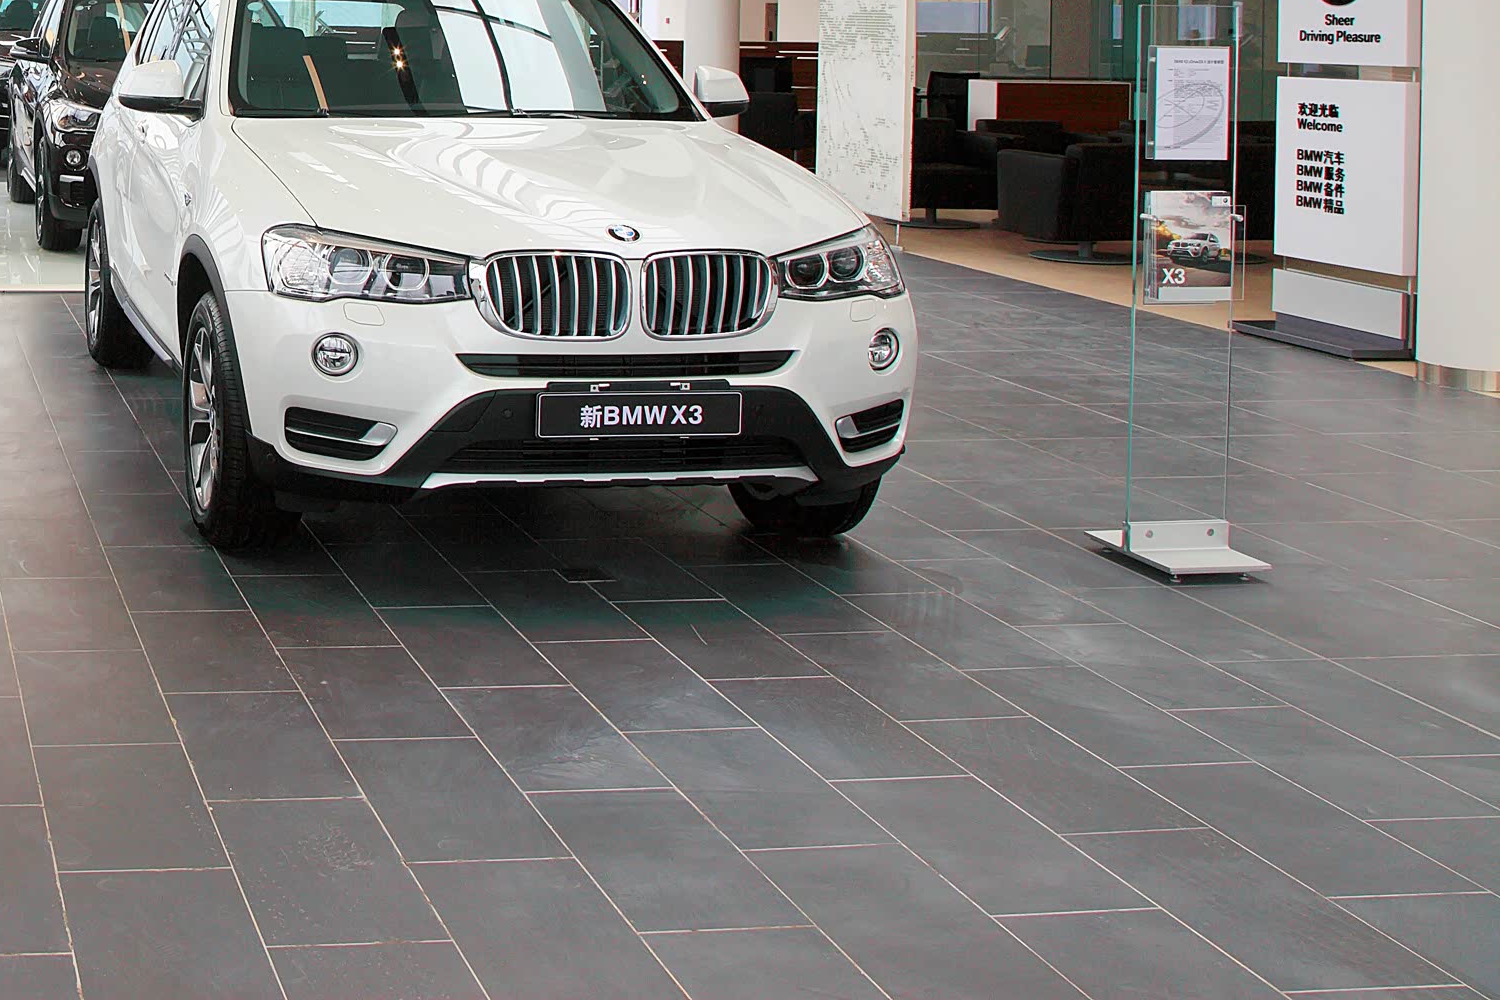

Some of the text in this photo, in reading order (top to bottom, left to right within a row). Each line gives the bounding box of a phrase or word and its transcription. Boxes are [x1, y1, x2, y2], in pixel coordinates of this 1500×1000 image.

[1324, 13, 1355, 26] Sheer
[1299, 29, 1381, 45] Driving Pleasure
[1297, 102, 1340, 118] 欢迎光临
[1297, 117, 1343, 132] Welcome
[1161, 267, 1186, 284] X3
[580, 404, 703, 428] 新BMW X3
